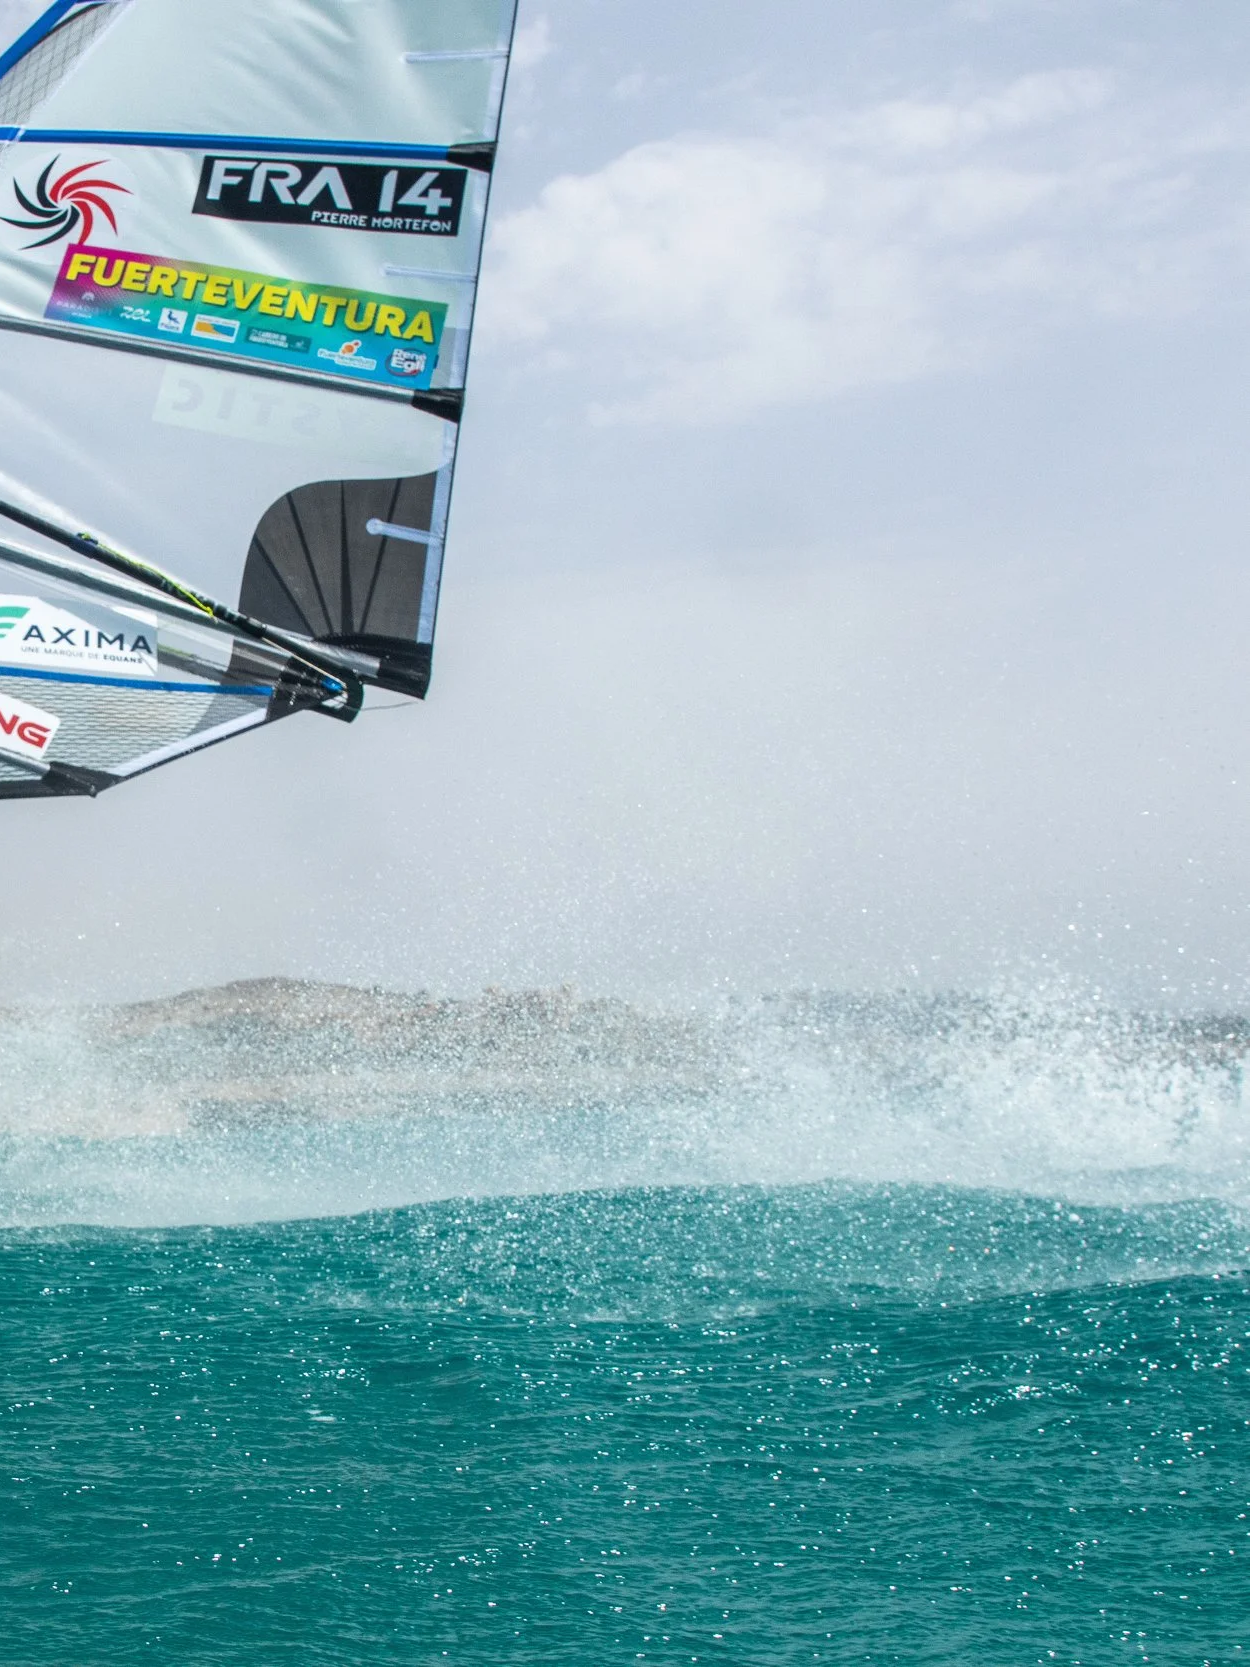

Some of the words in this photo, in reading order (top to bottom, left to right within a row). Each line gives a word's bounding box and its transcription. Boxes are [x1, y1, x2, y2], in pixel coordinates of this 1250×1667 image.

[206, 160, 352, 210] FRA
[378, 170, 452, 215] 14
[311, 211, 366, 227] PIERRE
[66, 254, 434, 343] FUERTEVENTURA
[21, 646, 40, 654] UNE
[44, 648, 84, 658] MARQUE
[22, 624, 153, 654] AXIMA
